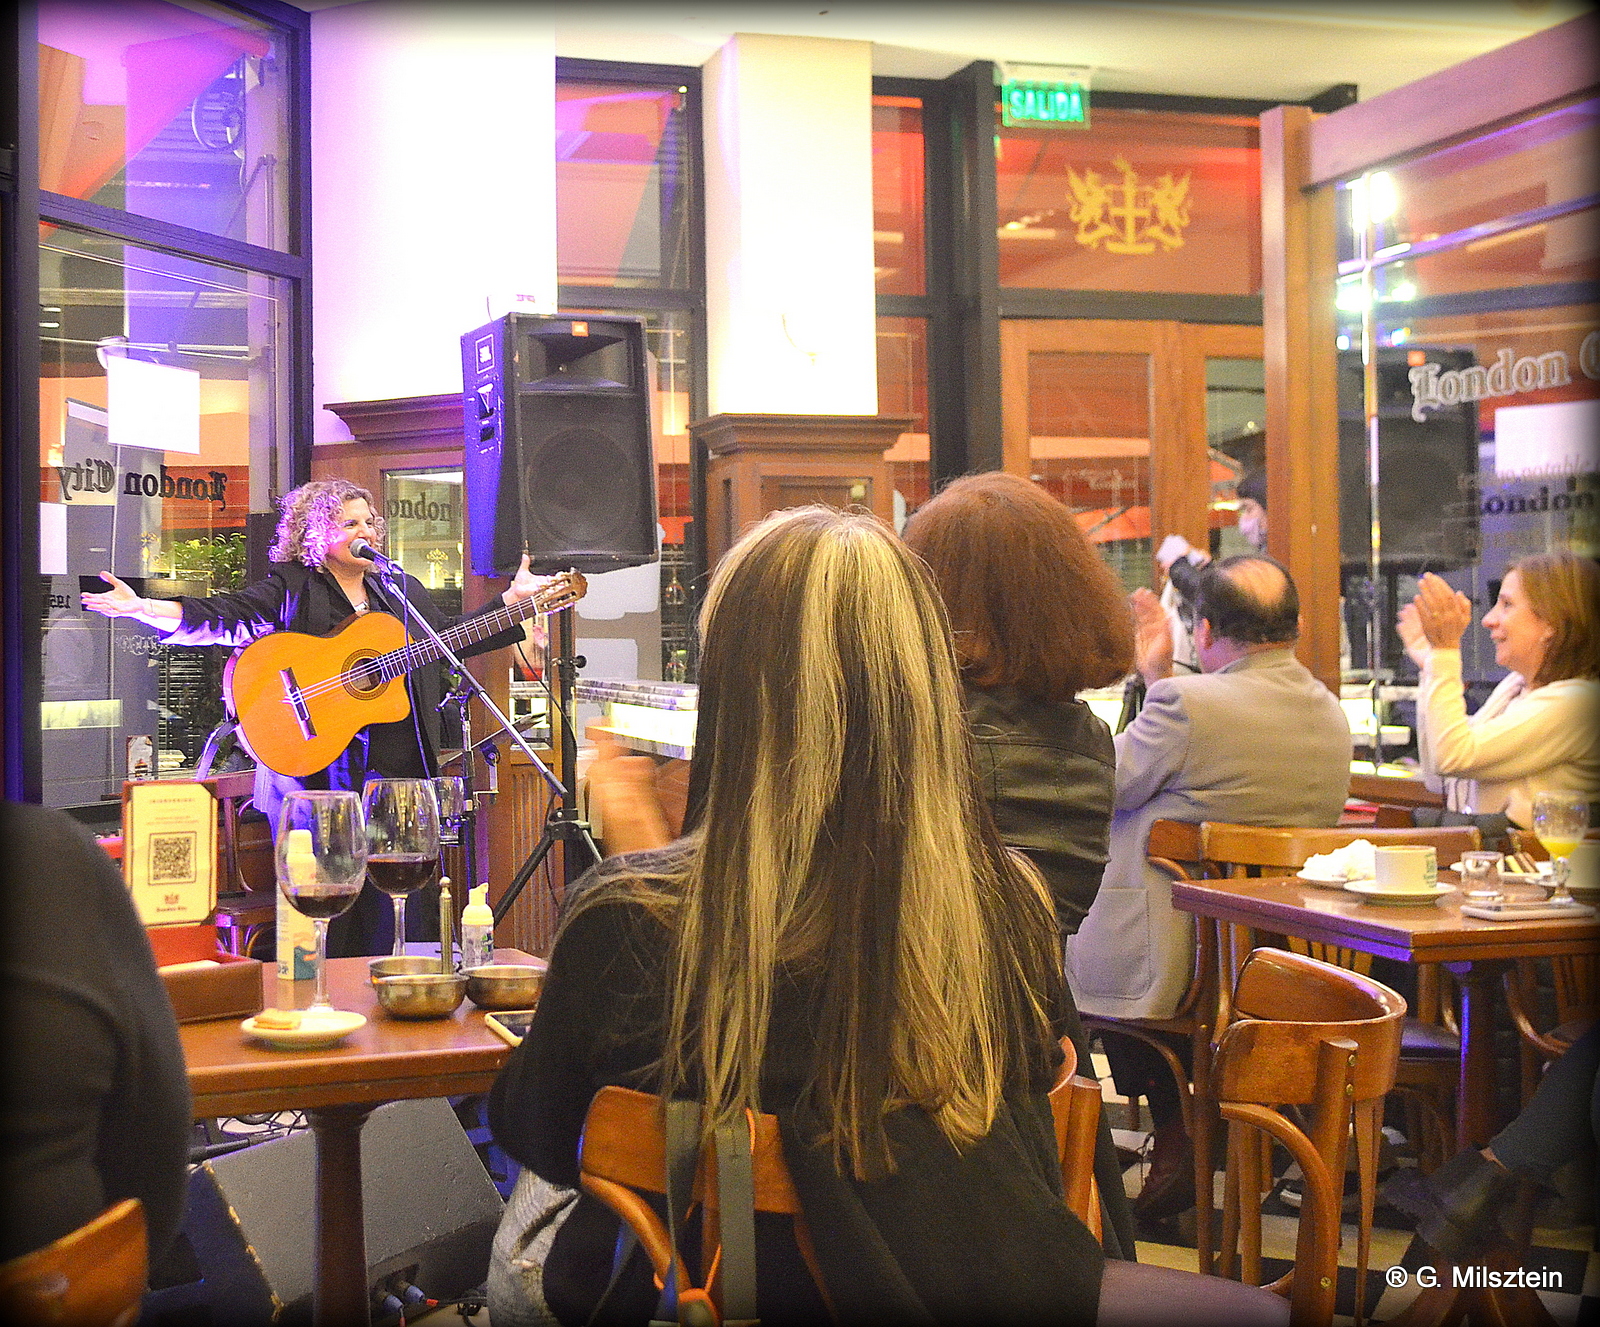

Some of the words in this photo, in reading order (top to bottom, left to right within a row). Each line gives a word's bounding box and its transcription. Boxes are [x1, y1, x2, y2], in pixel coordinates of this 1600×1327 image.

[1010, 89, 1084, 122] SALIDA
[1408, 348, 1572, 423] London
[387, 491, 453, 522] ondon
